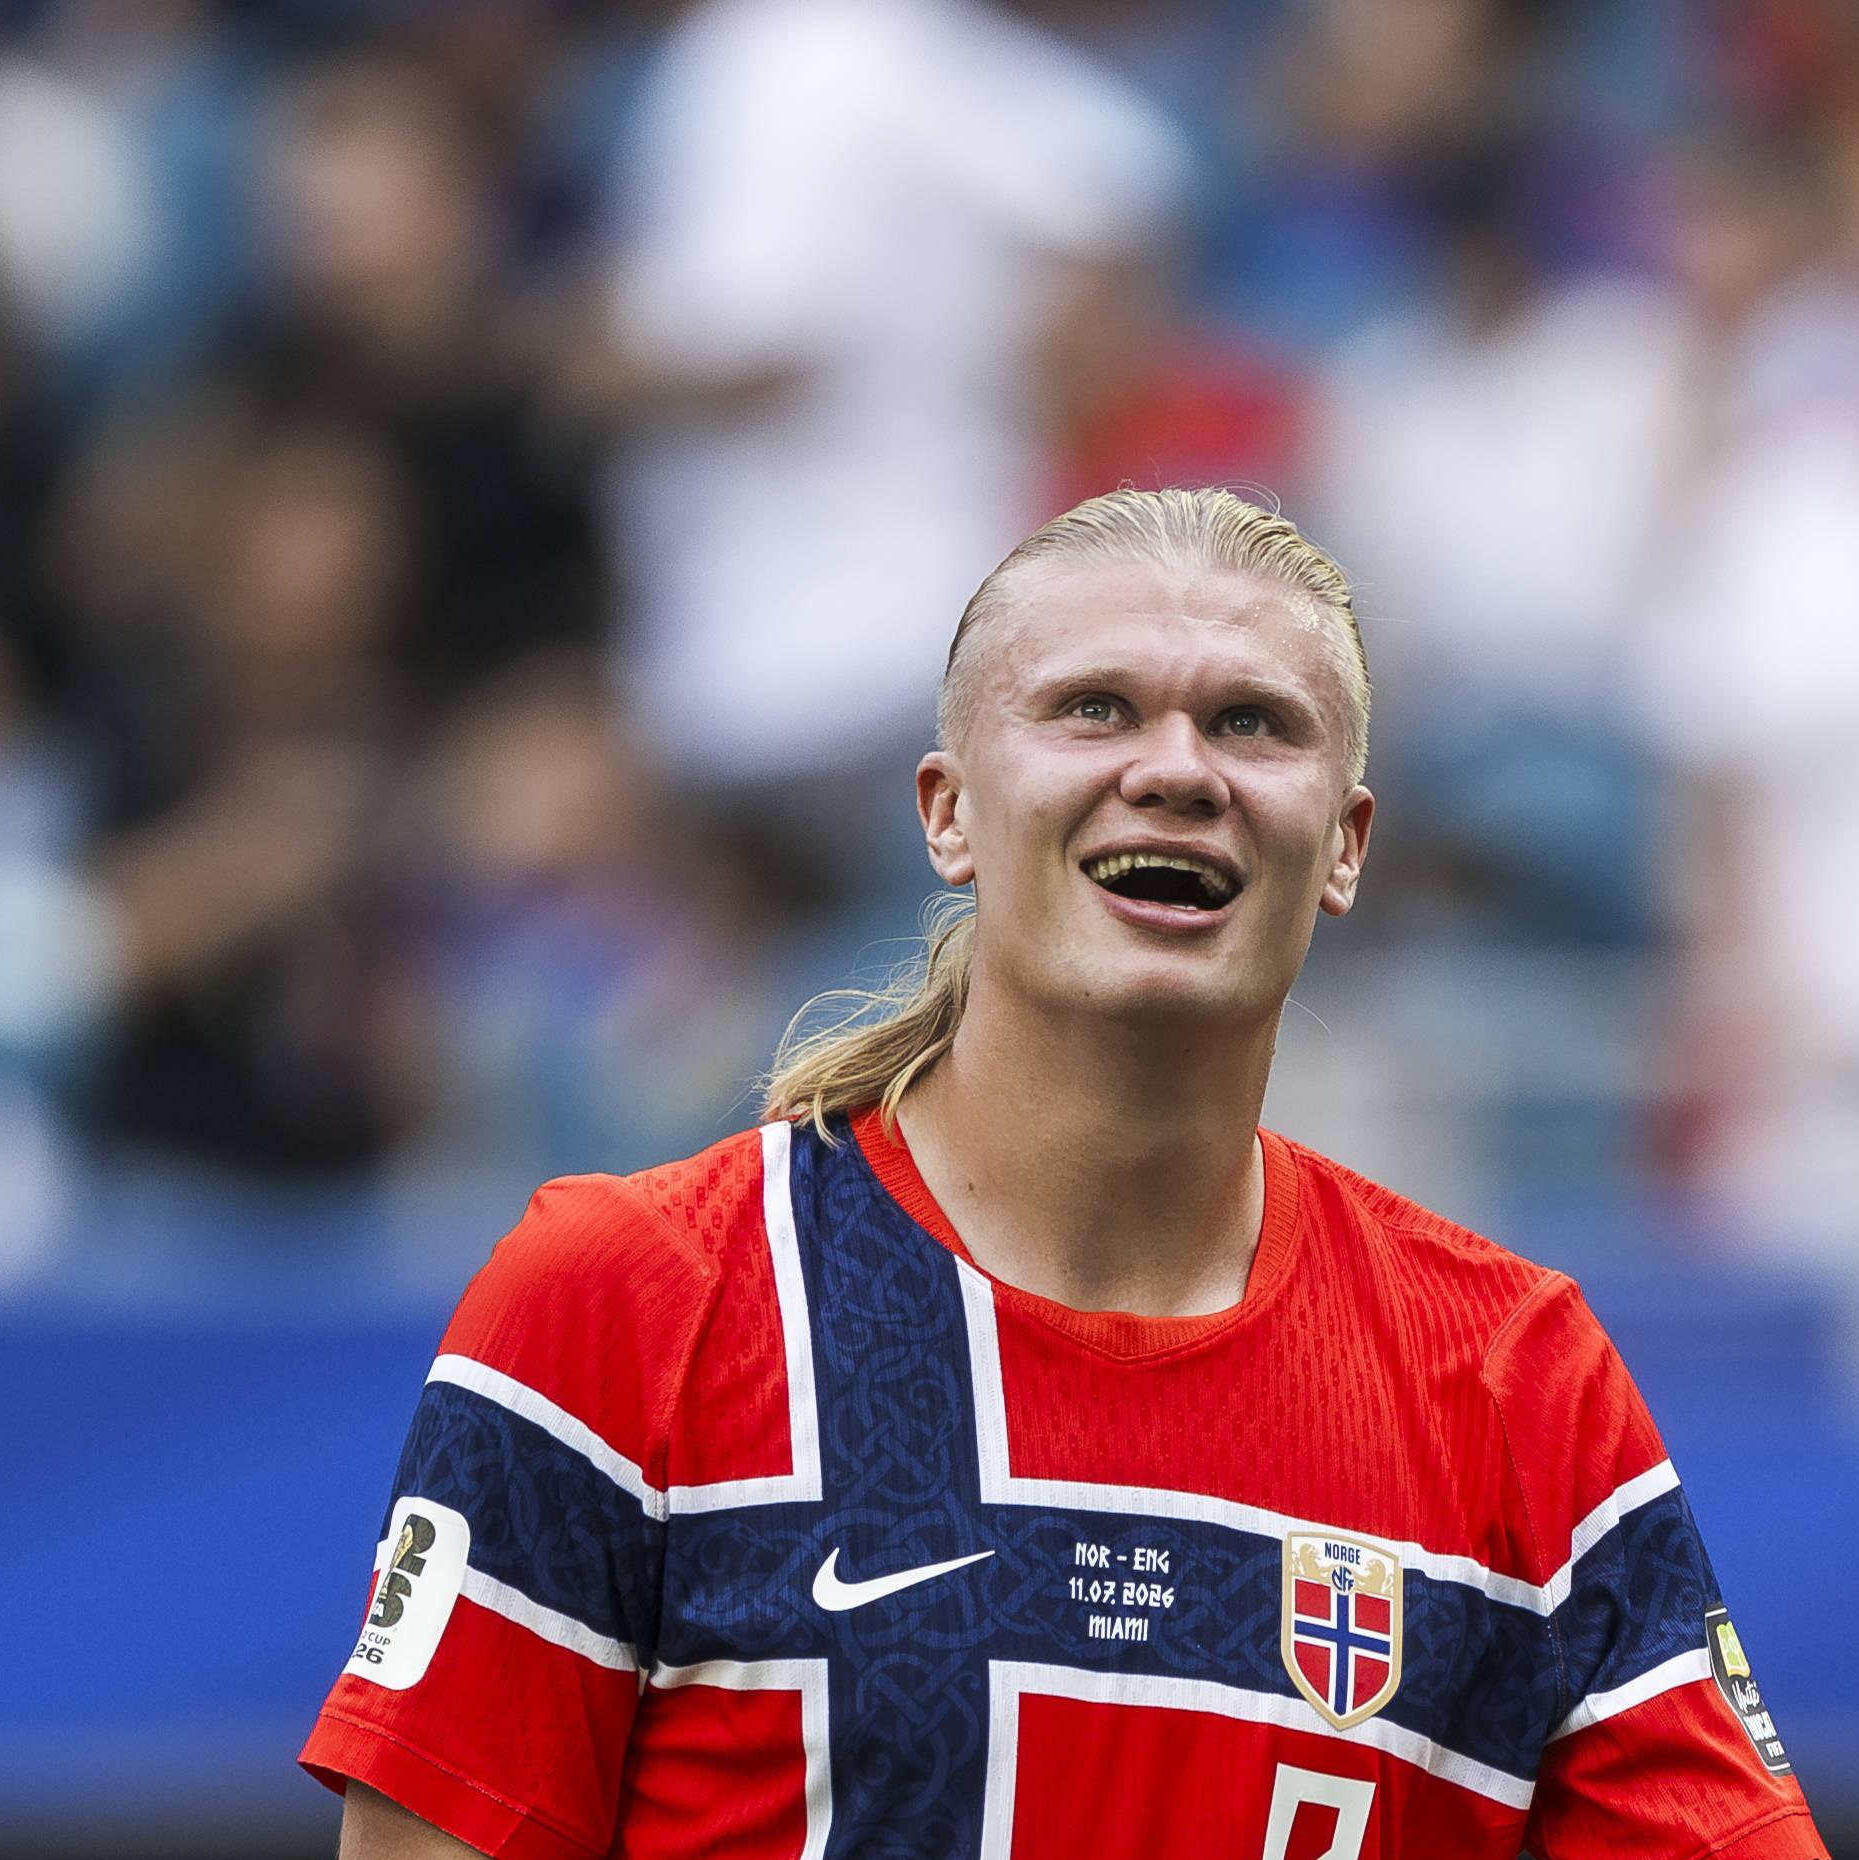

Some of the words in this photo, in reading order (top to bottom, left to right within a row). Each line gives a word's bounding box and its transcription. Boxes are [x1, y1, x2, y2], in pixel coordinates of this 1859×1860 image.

[1075, 1542, 1111, 1569] NOR
[1132, 1547, 1170, 1574] ENG
[1324, 1541, 1361, 1566] NORGE
[367, 1631, 392, 1647] CUP
[1088, 1614, 1149, 1642] MIAMI
